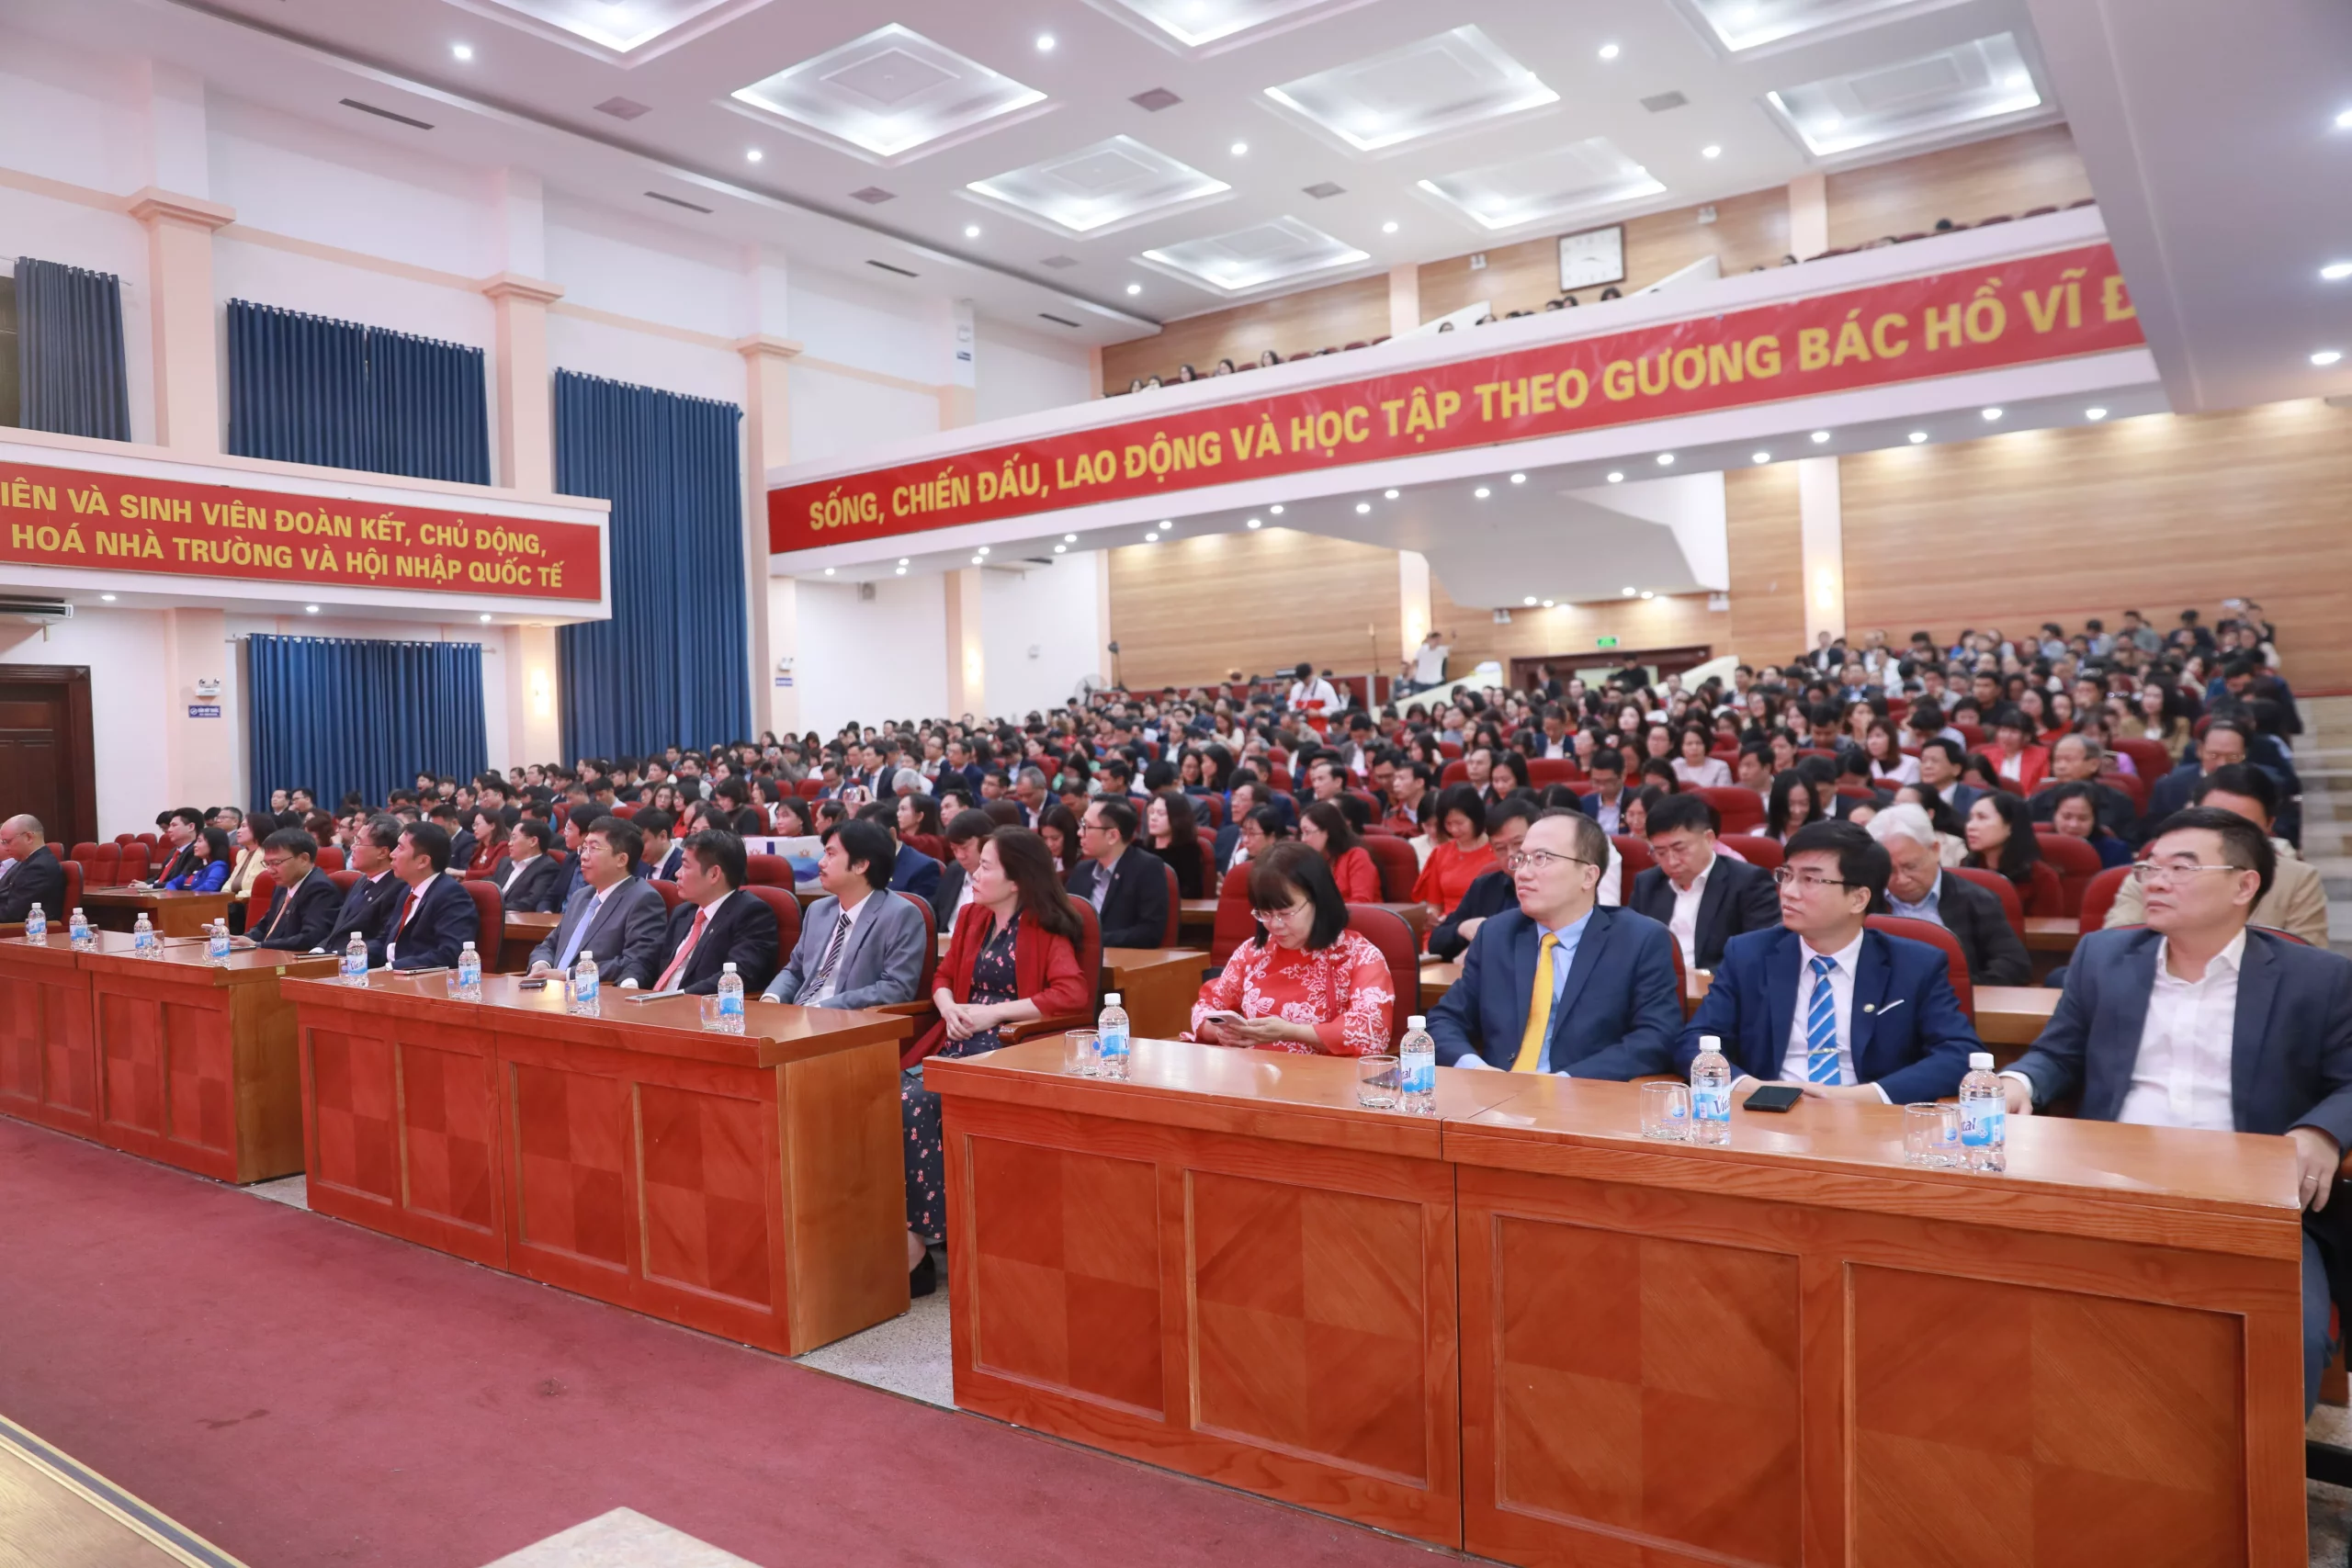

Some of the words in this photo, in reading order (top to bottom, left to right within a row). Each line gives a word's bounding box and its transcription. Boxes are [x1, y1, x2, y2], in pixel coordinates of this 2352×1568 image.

[809, 486, 885, 530] SỐNG,
[893, 467, 970, 515] CHIẾN
[977, 453, 1049, 502] ĐẤU,
[1057, 450, 1116, 490] LAO
[1125, 431, 1221, 484] ĐỘNG
[1231, 412, 1283, 460] VÀ
[1291, 407, 1370, 457] HỌC
[1381, 386, 1462, 444] TẬP
[1474, 369, 1589, 421] THEO
[1602, 335, 1781, 400] GƯƠNG
[1799, 310, 1908, 370] BÁC
[1926, 277, 2006, 350] HỒ
[2021, 266, 2087, 334] VĨ
[12, 522, 86, 553] HOÁ
[96, 528, 164, 559] NHÀ
[173, 535, 292, 569] TRƯỜNG
[300, 544, 338, 571] VÀ
[346, 547, 389, 580] HỘI
[396, 554, 461, 584] NHẬP
[468, 557, 531, 586] QUỐC
[537, 560, 565, 588] TẾ
[67, 484, 110, 516] VÀ
[119, 493, 192, 523] SINH
[201, 499, 266, 530] VIÊN
[274, 506, 352, 537] ĐOÀN
[361, 512, 412, 548] KẾT,
[420, 519, 469, 548] CHỦ
[475, 525, 547, 558] ĐỘNG,
